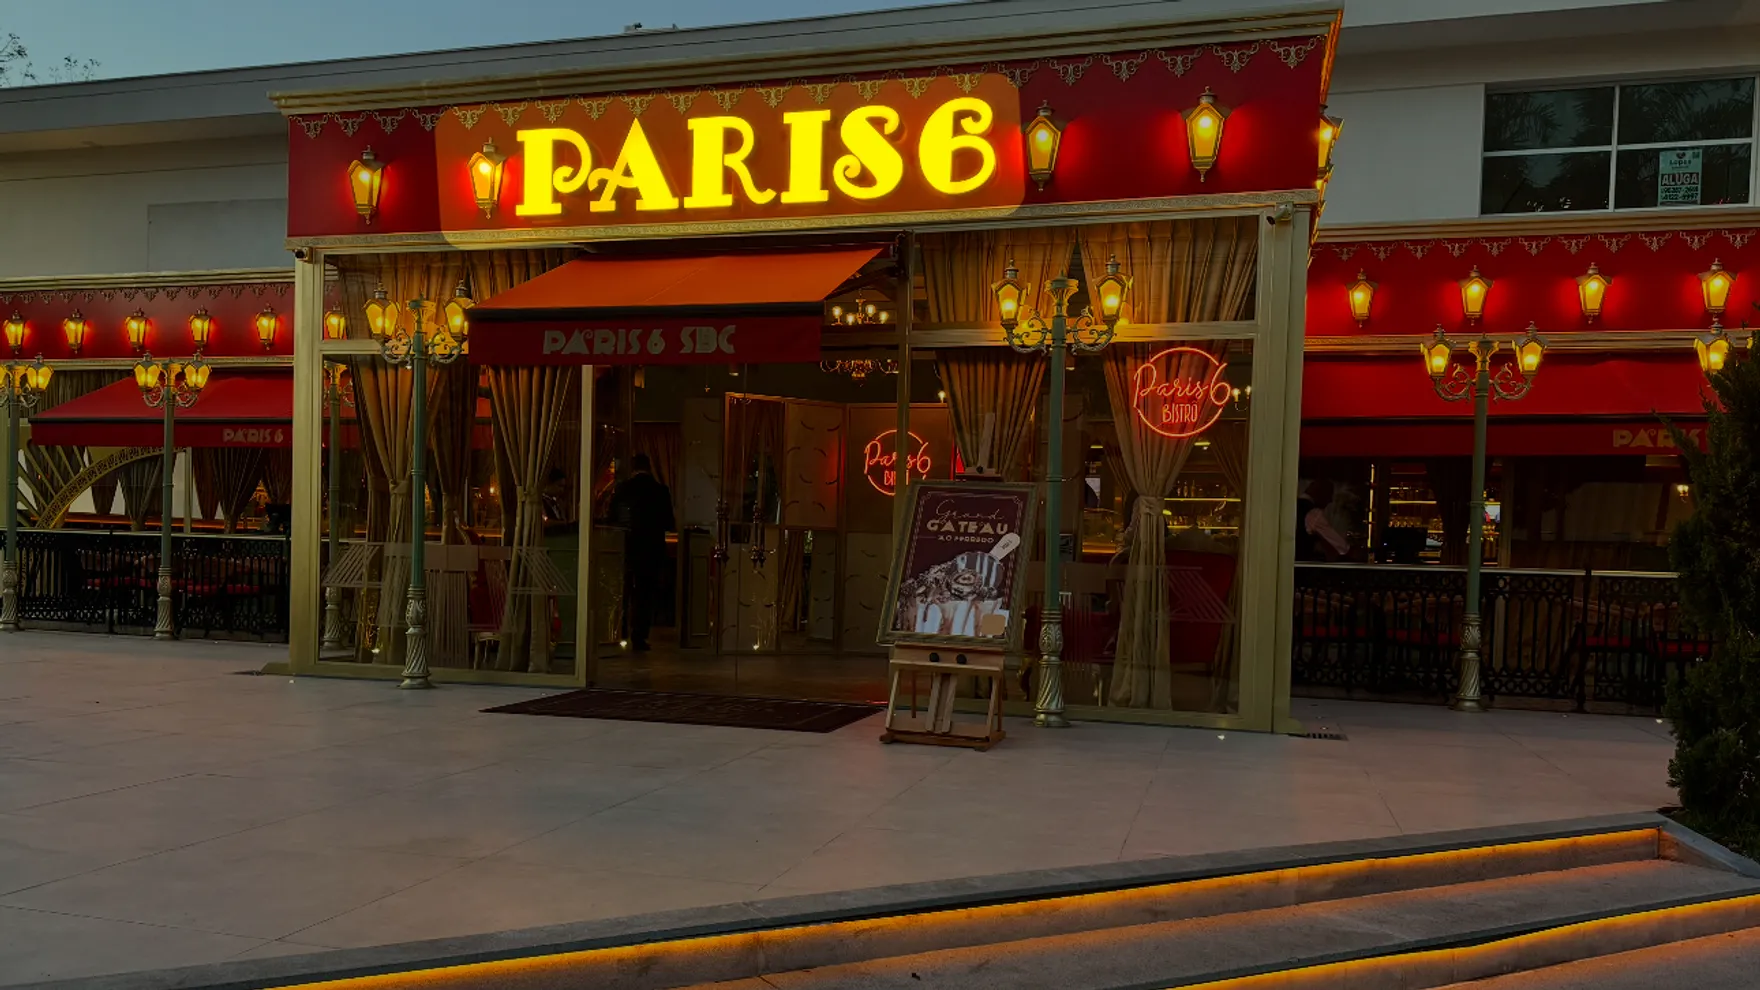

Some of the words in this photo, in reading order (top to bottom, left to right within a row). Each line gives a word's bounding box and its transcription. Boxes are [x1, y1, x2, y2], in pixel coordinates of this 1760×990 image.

[515, 104, 904, 216] PARIS
[918, 97, 997, 195] 6
[1662, 174, 1698, 185] ALUGA
[543, 328, 643, 354] PARIS
[646, 328, 666, 355] 6
[679, 325, 736, 354] SBC
[1133, 362, 1209, 408] Paris
[1209, 362, 1232, 406] 6
[222, 428, 272, 442] PARIS
[274, 428, 284, 444] 6
[864, 440, 917, 475] Pars
[916, 441, 932, 474] 6
[936, 499, 1004, 524] Grand
